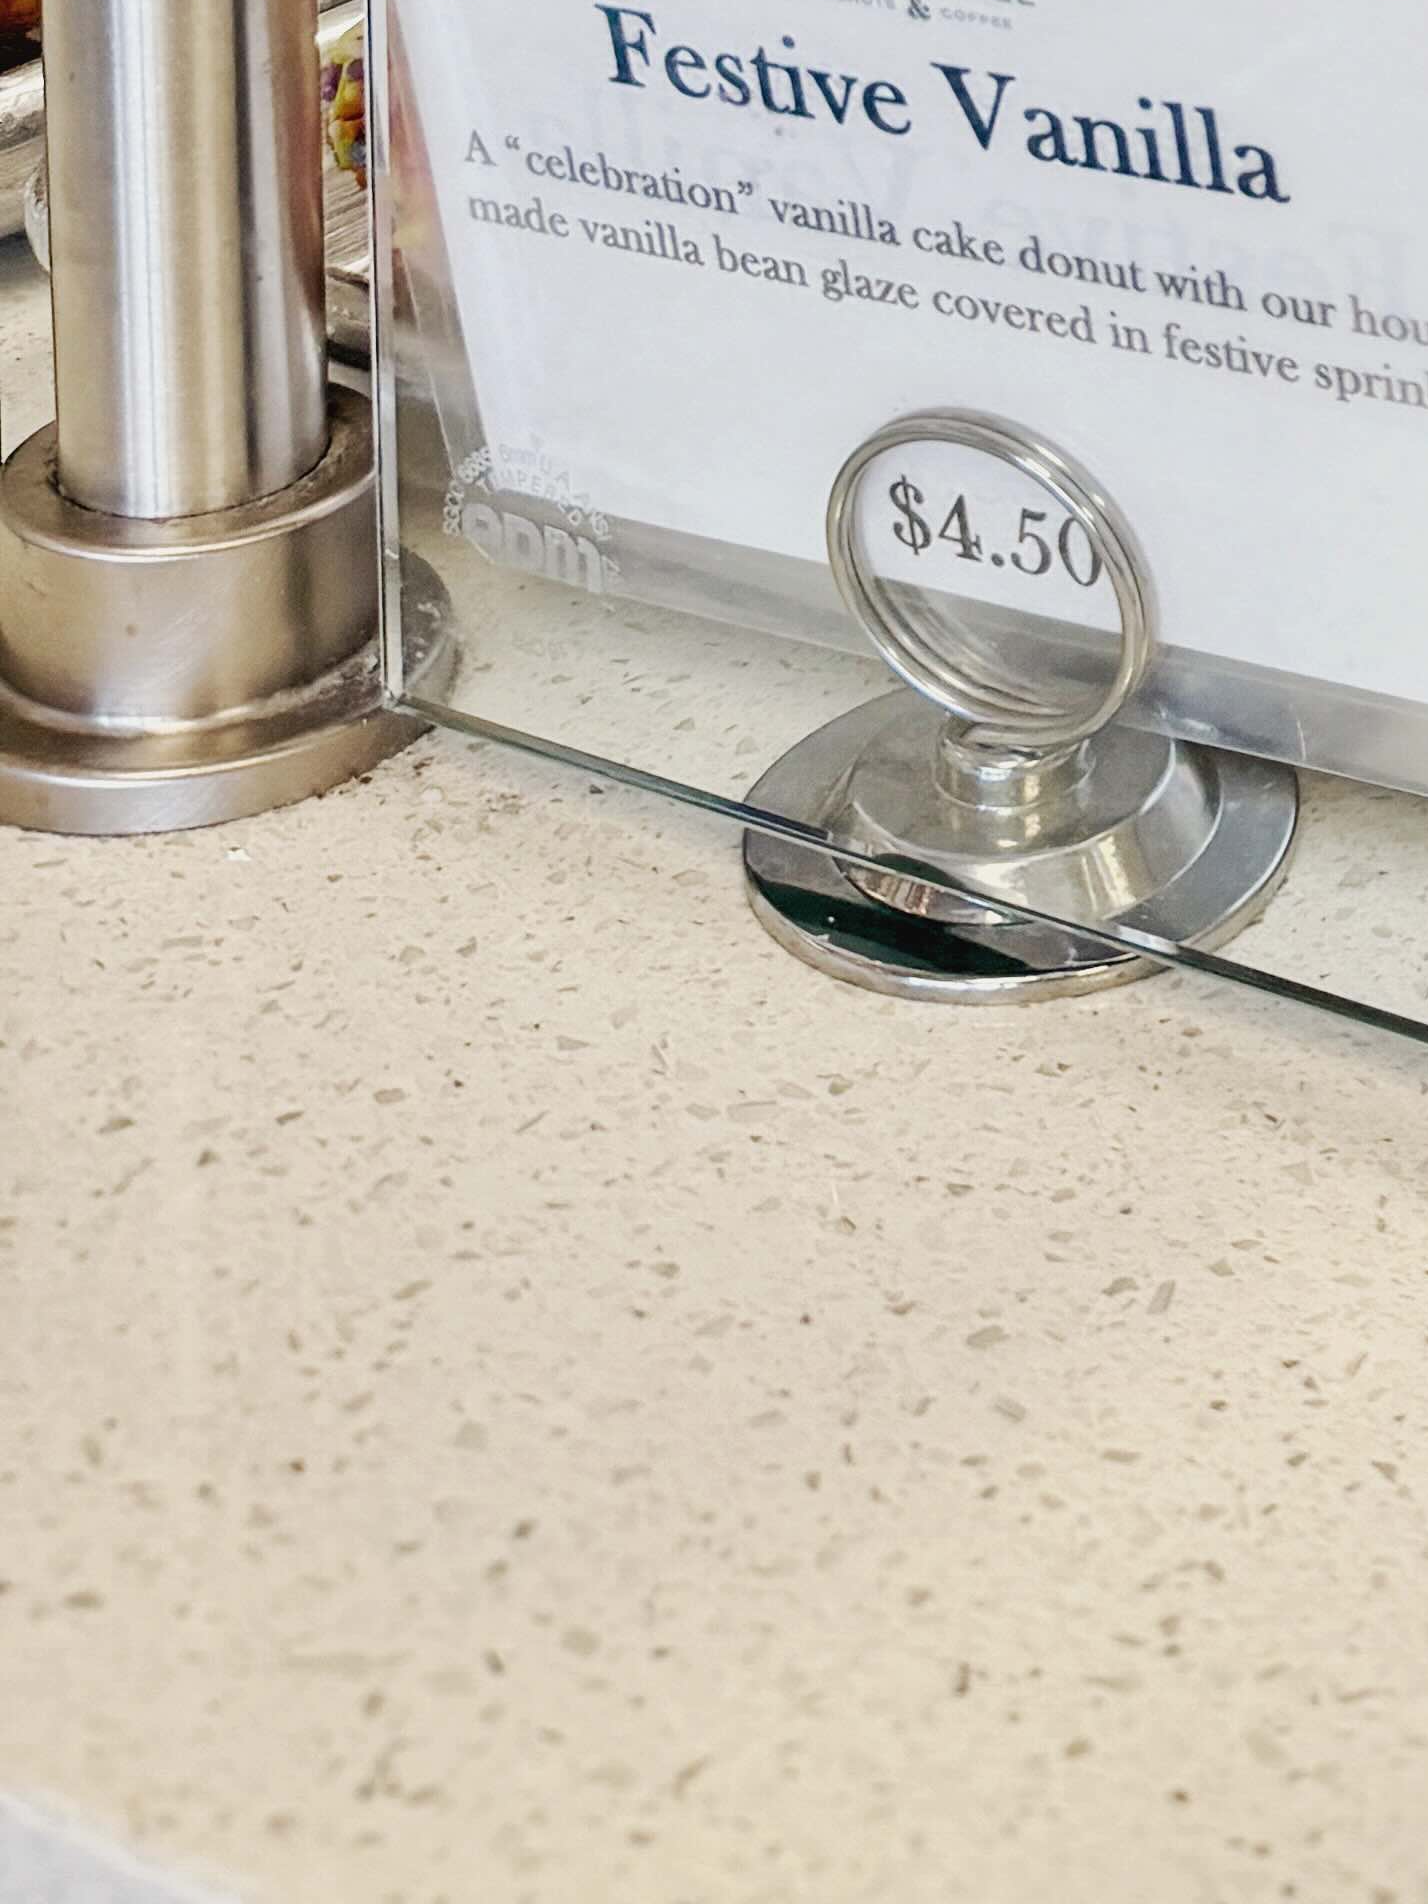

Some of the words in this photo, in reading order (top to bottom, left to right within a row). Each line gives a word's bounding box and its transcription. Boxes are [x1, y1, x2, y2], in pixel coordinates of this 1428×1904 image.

[594, 2, 913, 136] Festive
[930, 61, 1292, 205] Vanilla
[463, 128, 498, 169] A
[504, 135, 755, 216] “celebration”
[766, 195, 901, 248] vanilla
[912, 220, 1005, 266] cake
[1018, 234, 1146, 293] donut
[1153, 265, 1249, 313] with
[1261, 289, 1338, 329] our
[467, 195, 571, 239] made
[577, 221, 706, 267] vanilla
[711, 233, 811, 288] bean
[820, 258, 921, 310] glaze
[932, 290, 1098, 344] covered
[1108, 310, 1153, 355] in
[1163, 322, 1301, 384] festive
[888, 473, 1102, 588] $4.50
